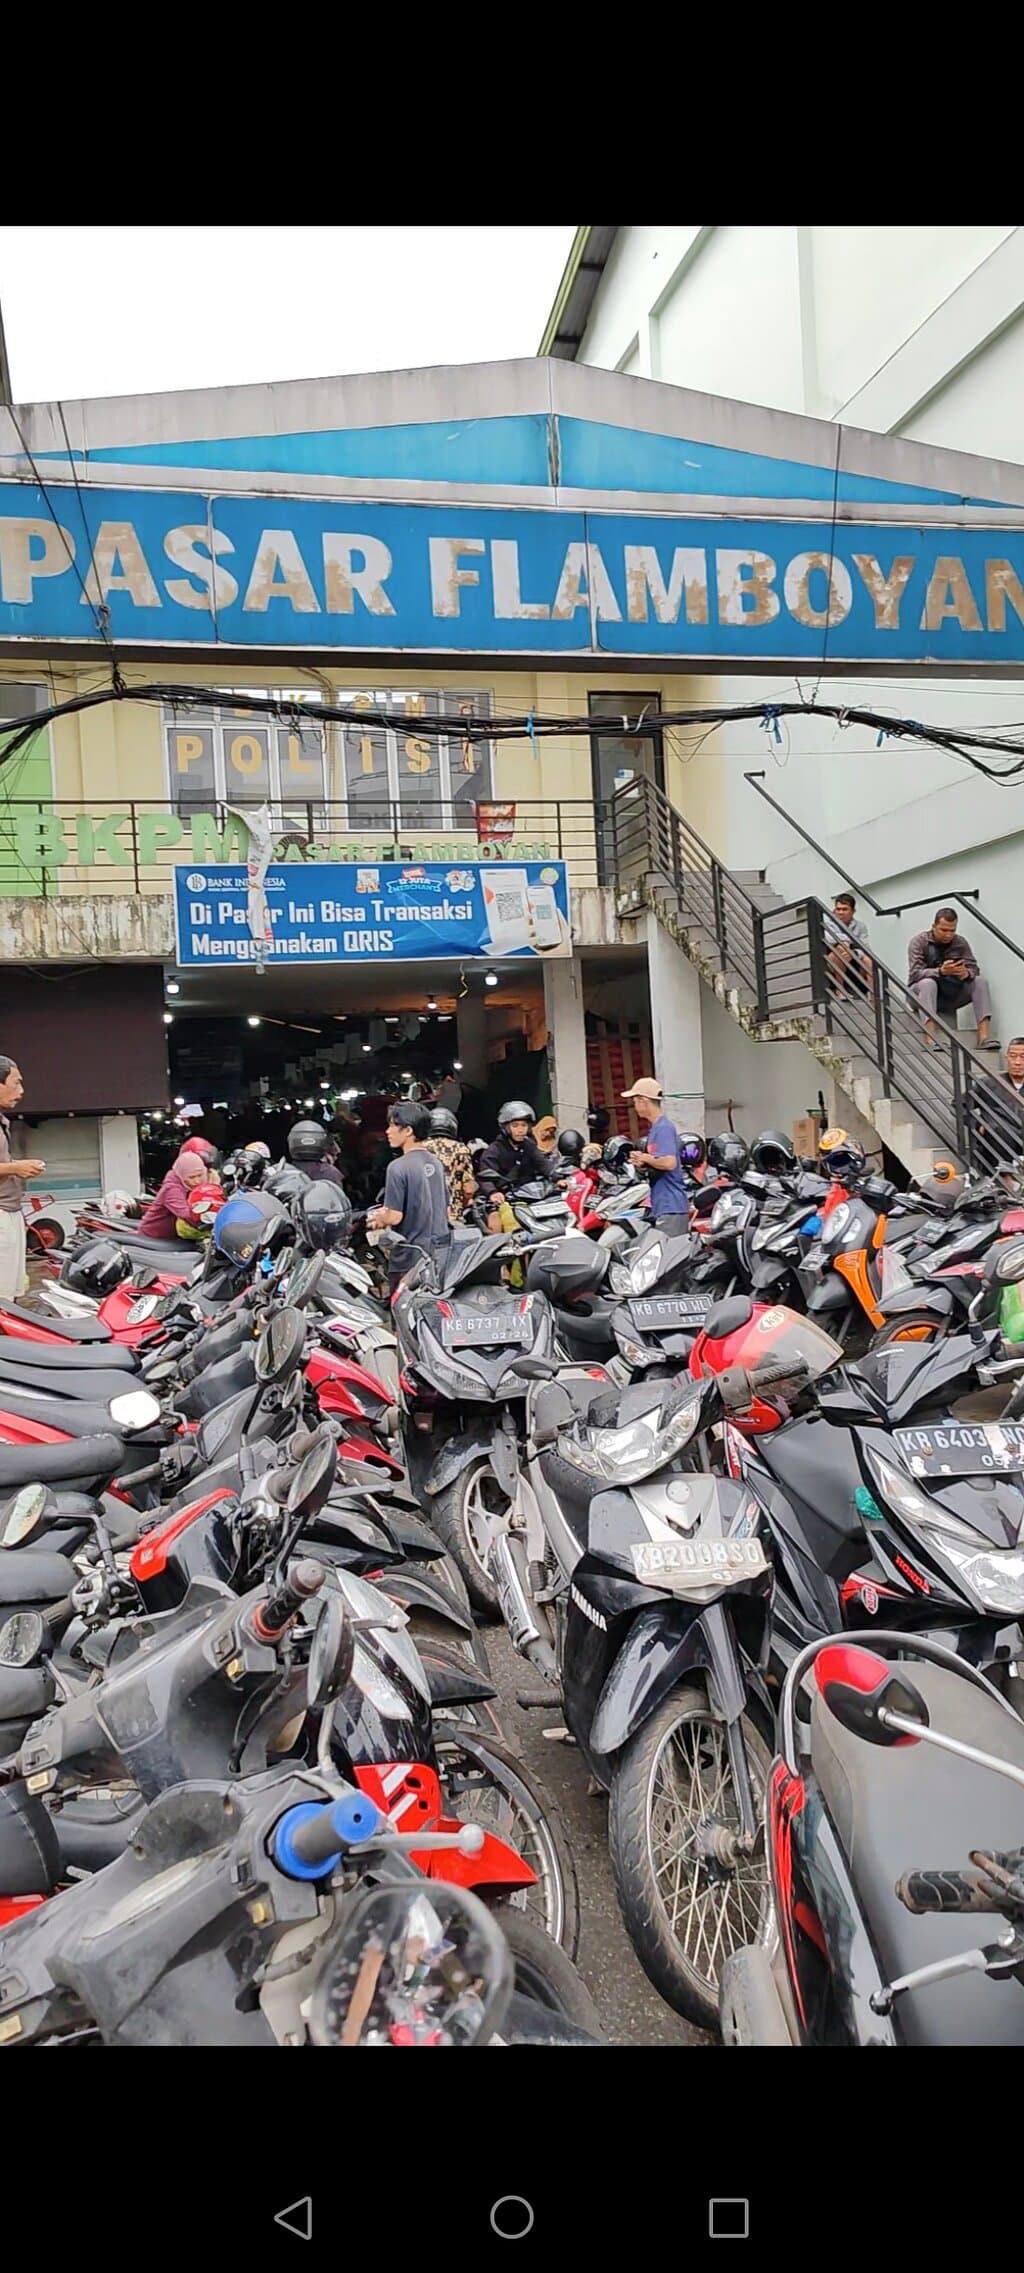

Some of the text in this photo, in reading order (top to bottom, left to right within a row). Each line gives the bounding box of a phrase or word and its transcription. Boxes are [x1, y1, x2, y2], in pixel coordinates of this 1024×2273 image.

[0, 516, 1024, 633] PASAR FLAMBOYAN
[175, 734, 476, 775] POLISI
[16, 813, 250, 866] BKPM
[271, 842, 360, 862] PASAR
[376, 842, 551, 861] FLAMBOYAN
[207, 877, 286, 887] BANK INNESIA
[189, 899, 473, 924] Di Par Ini Bisa Transaksi
[343, 930, 395, 951] QRIS
[635, 1303, 653, 1315] KB
[657, 1301, 688, 1314] 6770
[467, 1317, 500, 1330] 6737
[900, 1431, 932, 1451] KB
[934, 1428, 988, 1449] 6403
[895, 1554, 931, 1595] HONDA
[571, 1582, 608, 1632] YAMAHA
